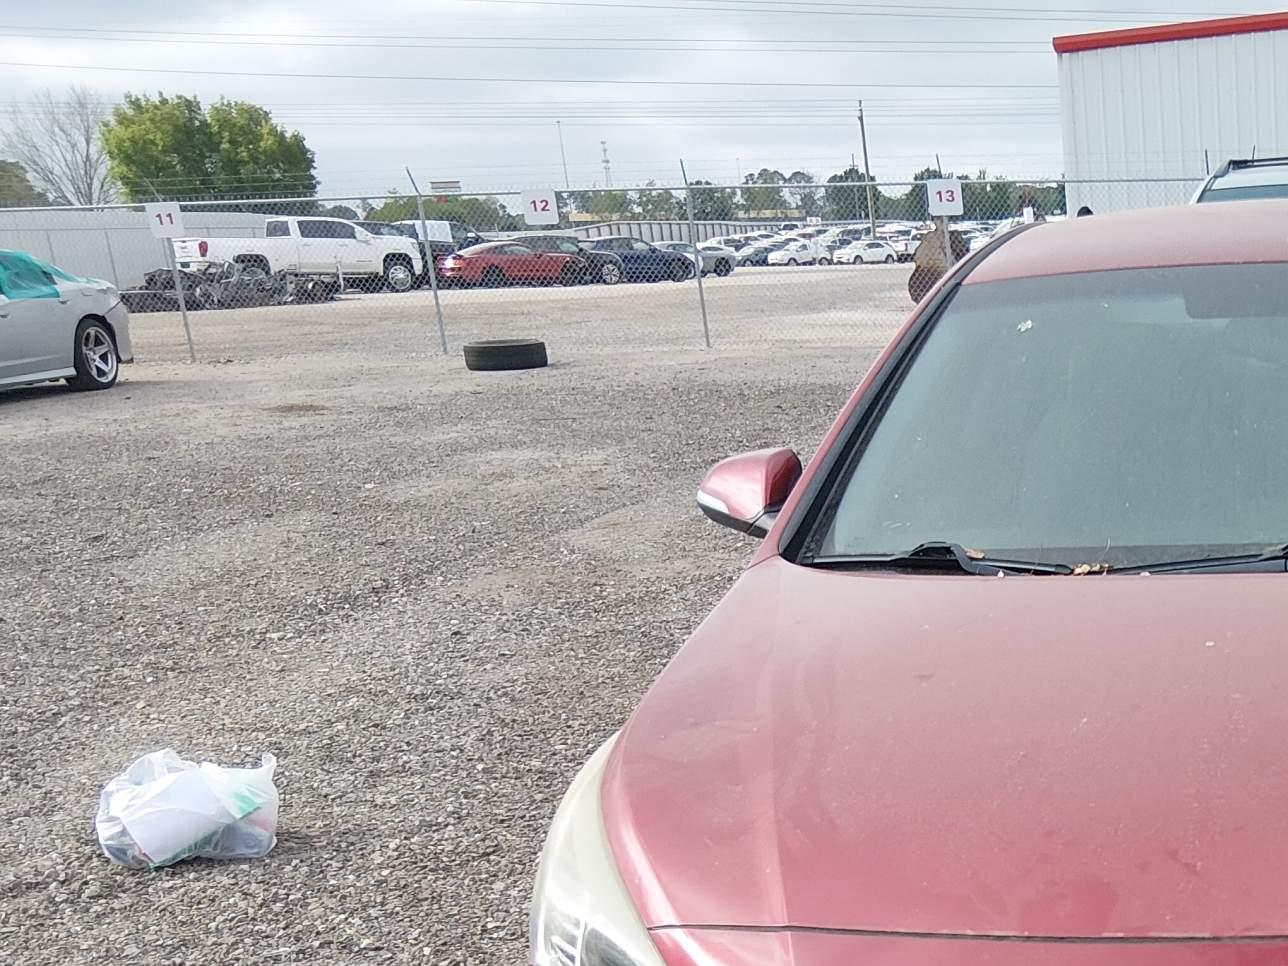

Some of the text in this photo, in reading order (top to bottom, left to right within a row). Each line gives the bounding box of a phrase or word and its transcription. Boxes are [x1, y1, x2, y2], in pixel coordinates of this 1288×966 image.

[935, 189, 955, 203] 13
[529, 199, 551, 212] 12
[155, 212, 174, 226] 11
